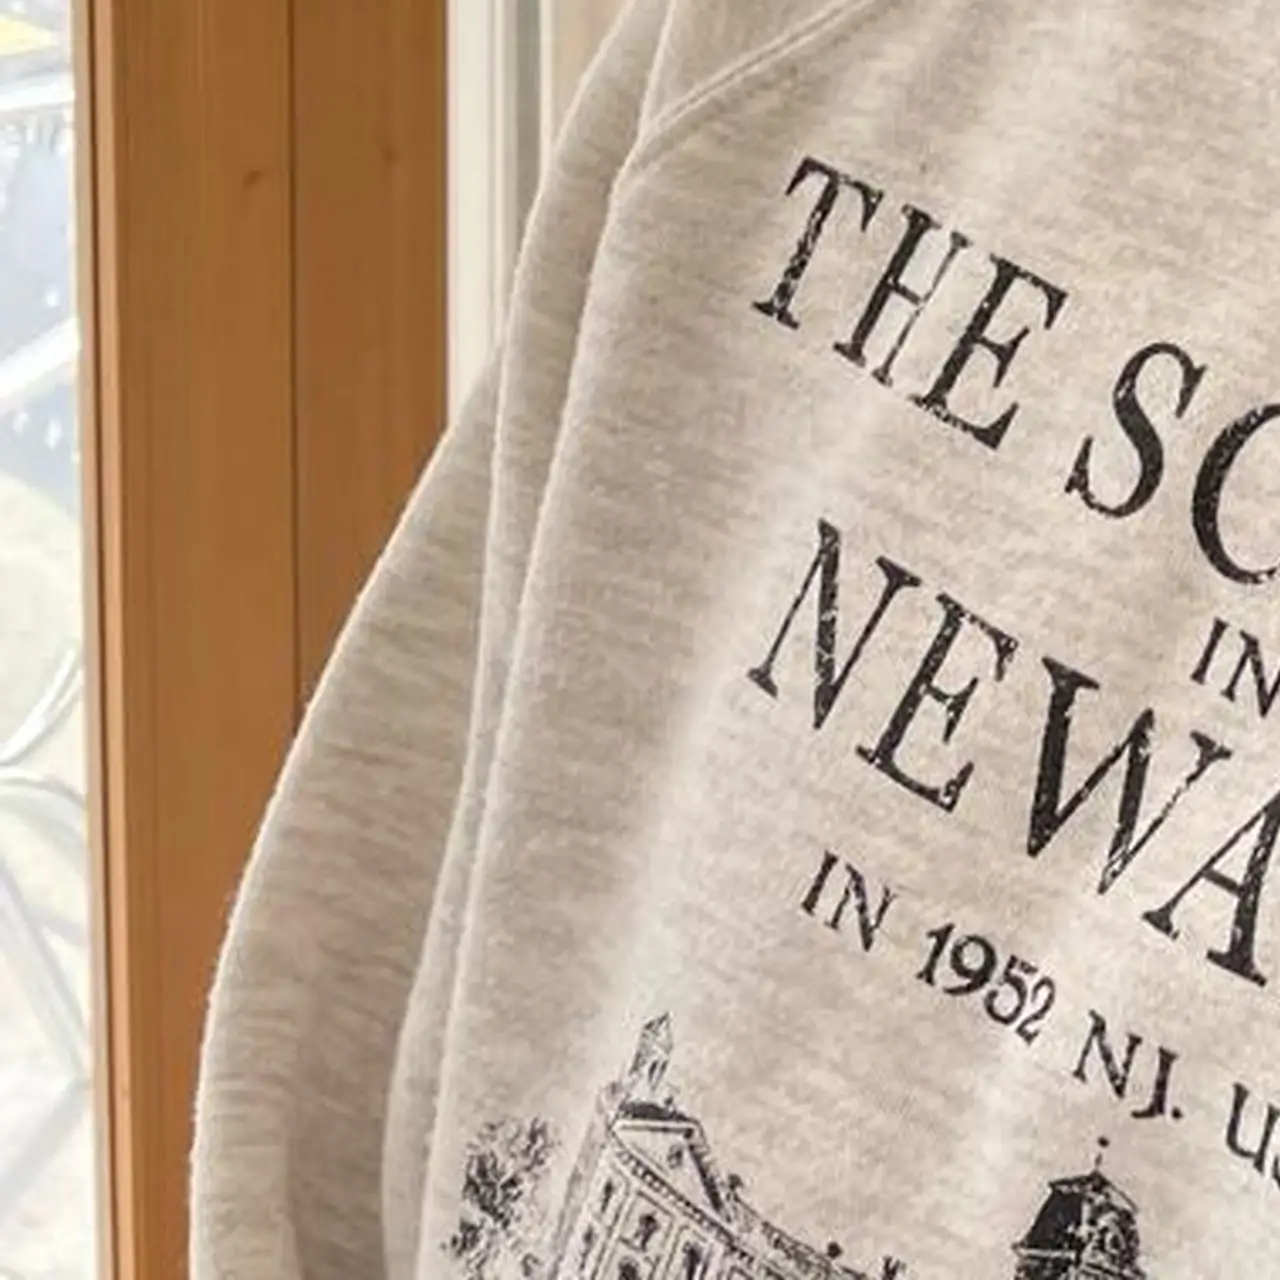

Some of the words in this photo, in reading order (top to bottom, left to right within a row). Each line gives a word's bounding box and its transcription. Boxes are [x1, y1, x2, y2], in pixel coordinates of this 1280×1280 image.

[751, 155, 1070, 452] THE
[799, 848, 899, 954] IN
[914, 921, 1057, 1048] 1952
